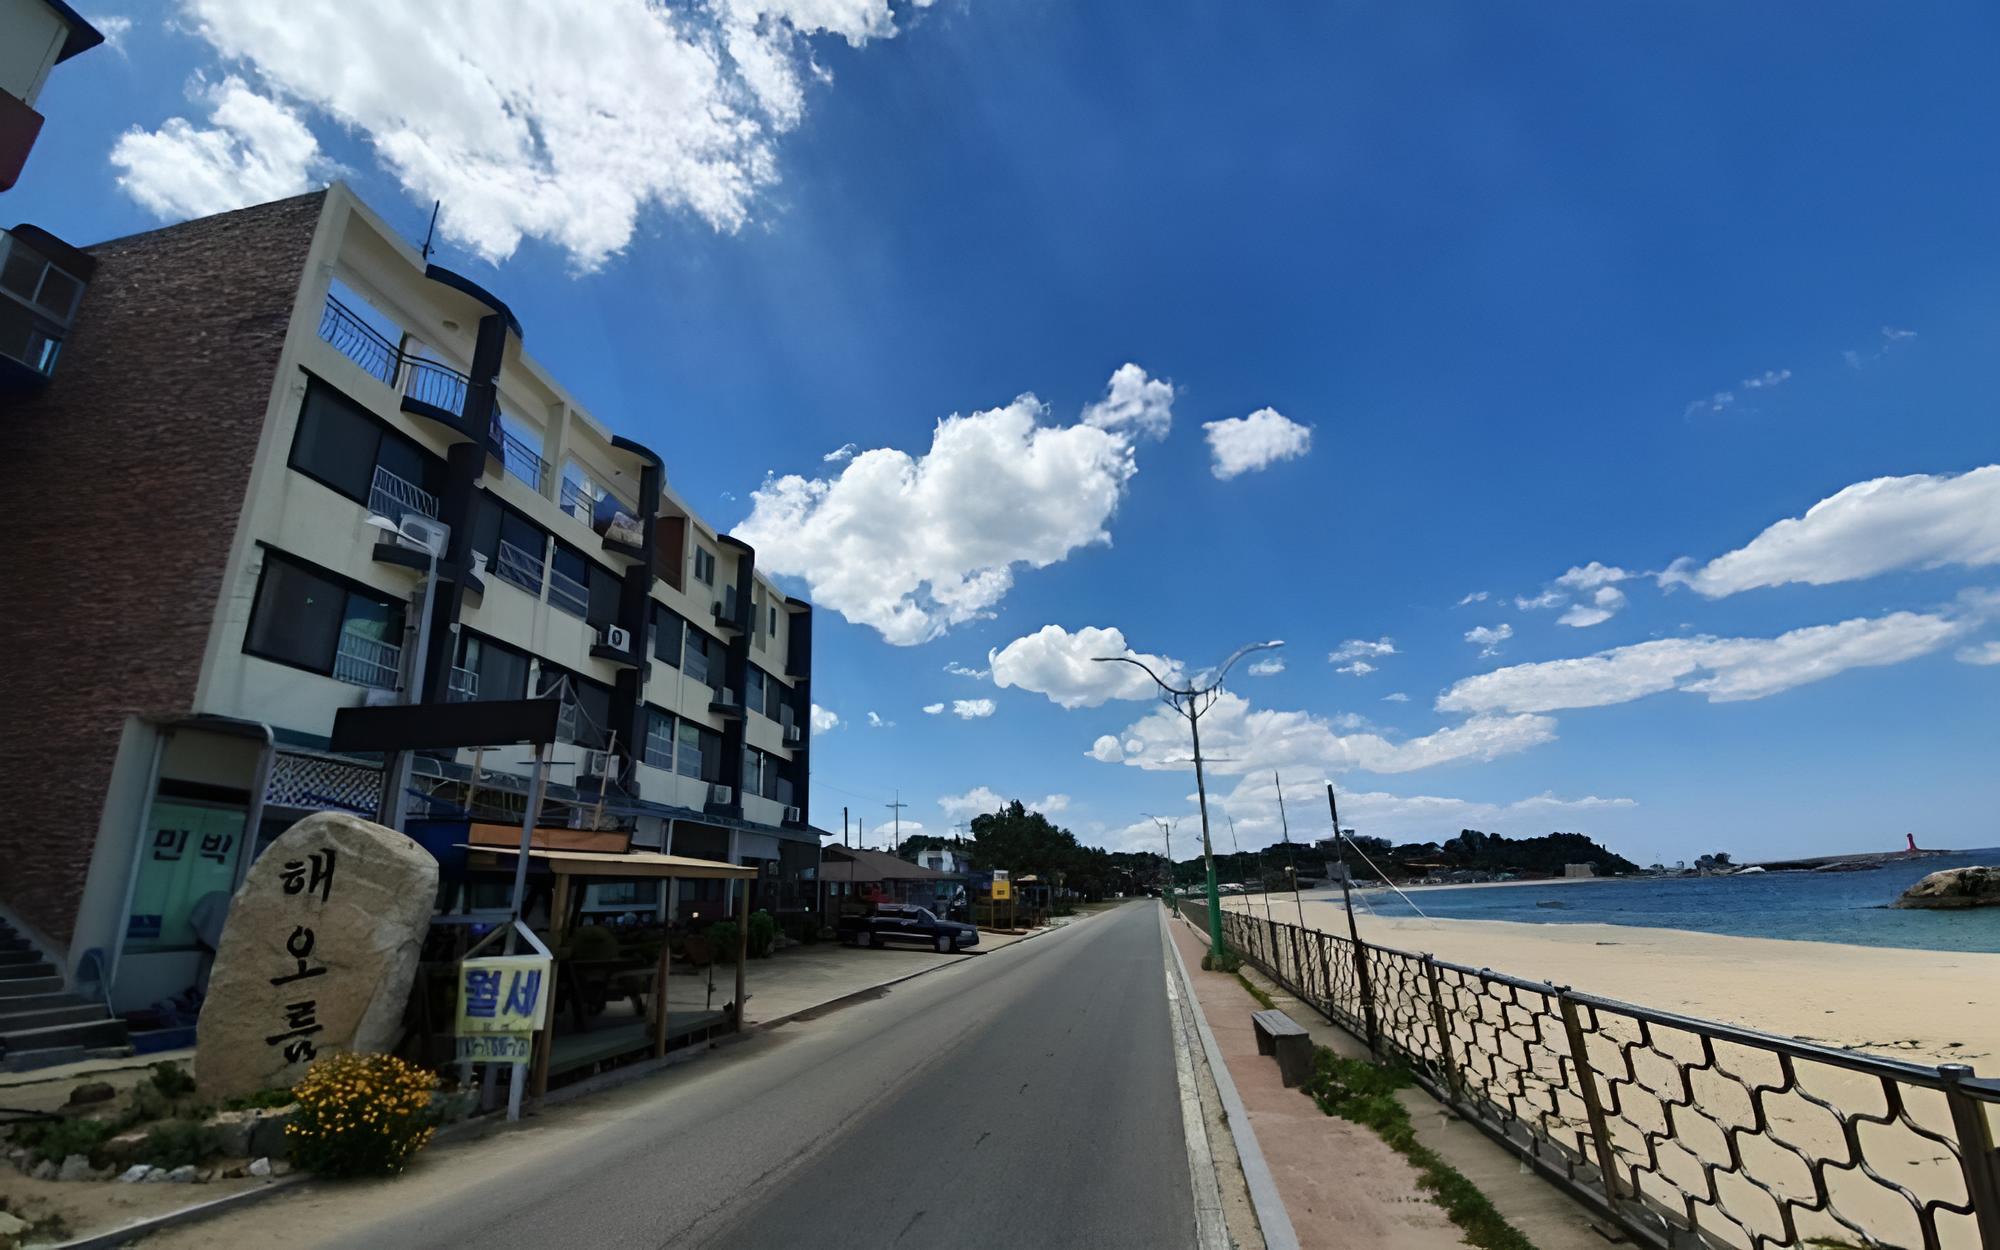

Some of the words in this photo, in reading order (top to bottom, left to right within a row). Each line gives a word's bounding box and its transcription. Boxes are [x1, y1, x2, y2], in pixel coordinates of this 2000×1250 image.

[153, 829, 233, 865] 민박
[265, 848, 336, 1063] 해오름
[465, 969, 542, 1018] 월세
